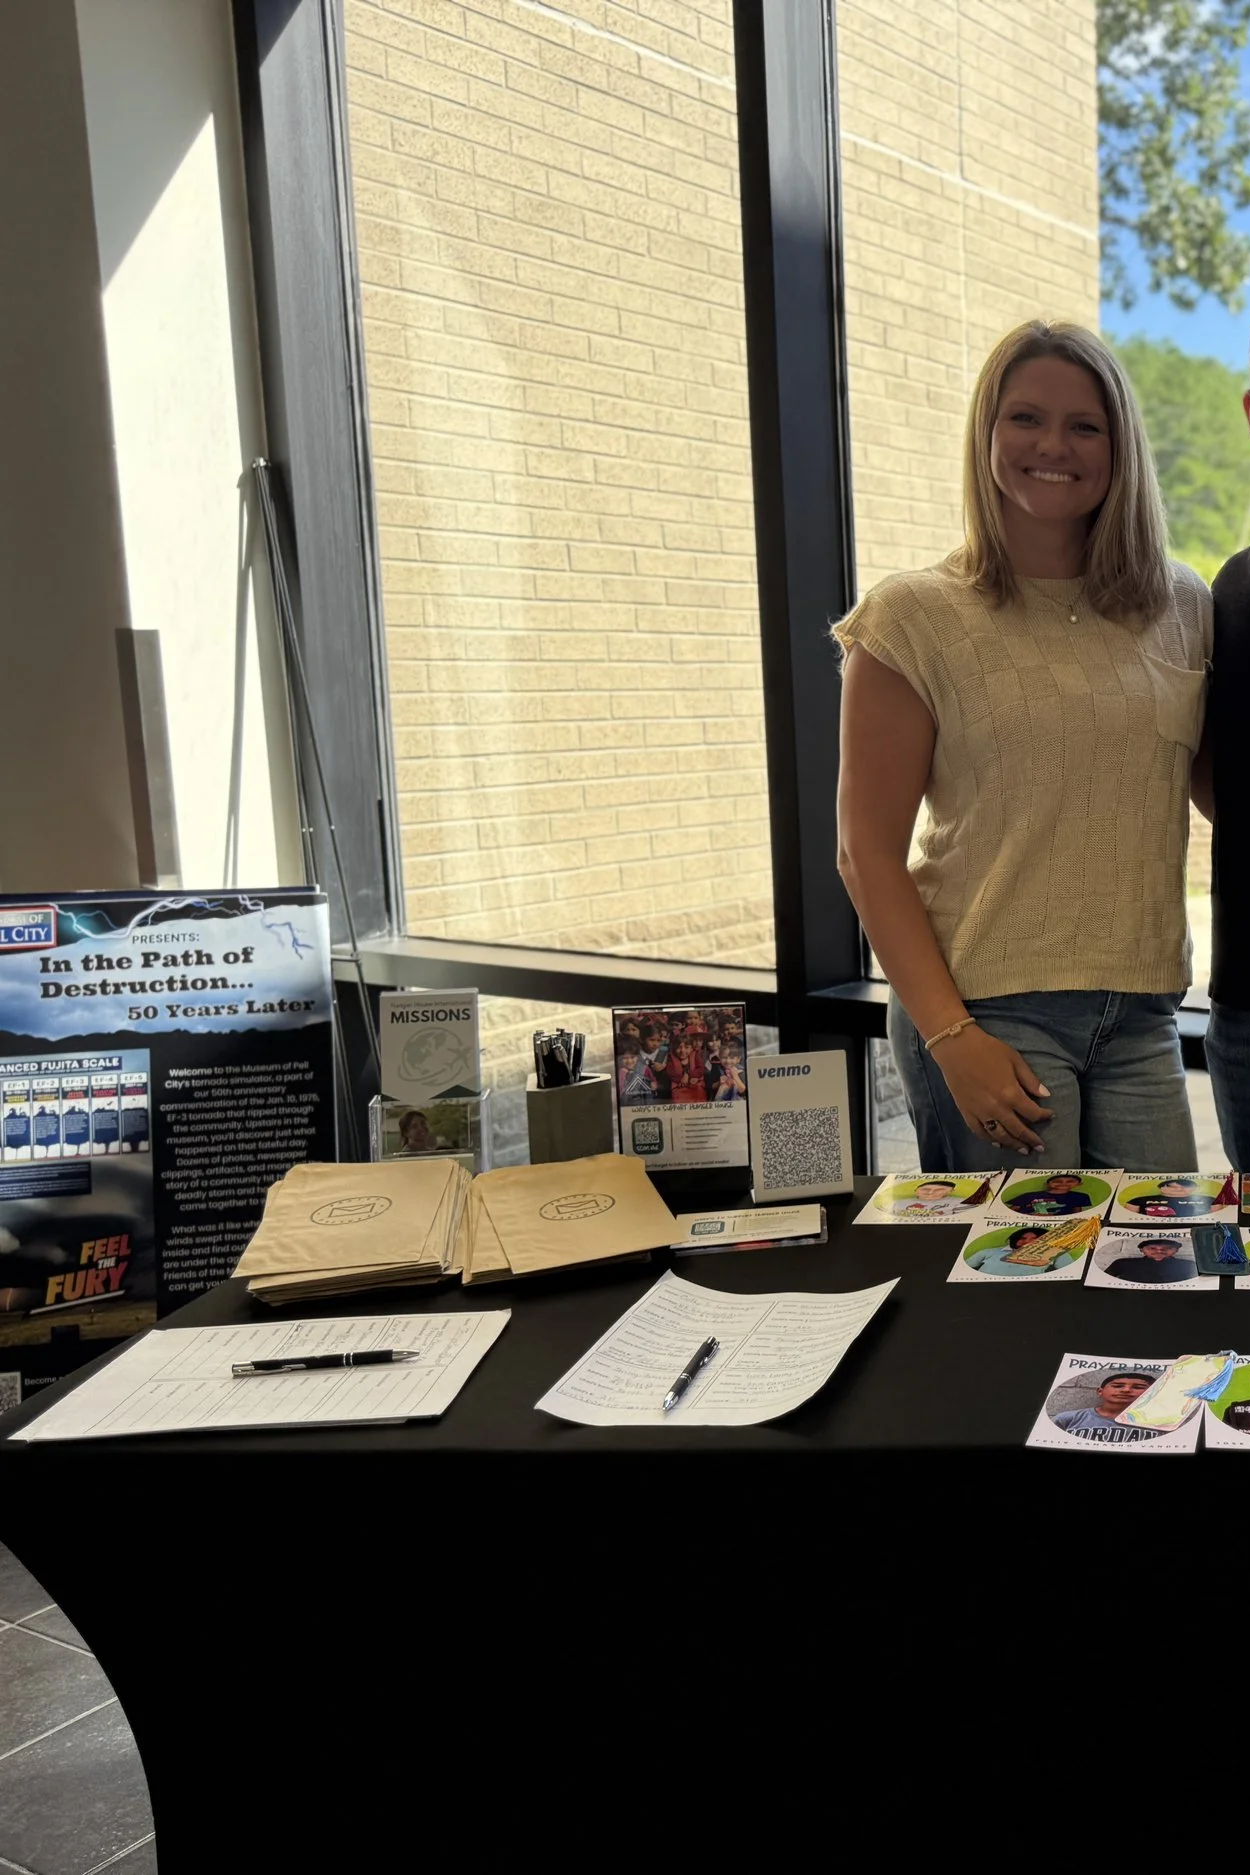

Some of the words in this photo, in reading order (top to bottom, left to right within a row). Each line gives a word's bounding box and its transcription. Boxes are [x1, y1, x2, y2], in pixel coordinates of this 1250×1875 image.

[29, 914, 44, 924] OF
[12, 926, 49, 942] CITY
[132, 932, 200, 945] PRESENTS:
[39, 954, 73, 974] In
[82, 952, 134, 971] the
[141, 949, 214, 969] Path
[223, 947, 255, 965] of
[40, 974, 254, 999] Destruction...
[128, 1004, 159, 1021] 50
[166, 1002, 239, 1019] Years
[246, 999, 316, 1015] Later
[390, 1008, 471, 1024] MISSIONS
[0, 1062, 39, 1073] ANCED
[41, 1059, 80, 1070] FUJITA
[82, 1056, 120, 1068] SCALE
[169, 1067, 213, 1078] Welcome
[214, 1066, 224, 1075] to
[226, 1065, 240, 1074] the
[242, 1063, 281, 1073] Museum
[282, 1062, 292, 1070] of
[293, 1061, 309, 1070] Pell
[757, 1064, 811, 1079] venmo
[165, 1080, 190, 1090] City's
[192, 1077, 228, 1087] tornado
[230, 1074, 274, 1085] simulator,
[284, 1073, 303, 1083] part
[304, 1071, 314, 1080] of
[194, 1090, 209, 1098] our
[212, 1088, 232, 1097] 50th
[234, 1085, 286, 1096] anniversary
[160, 1100, 237, 1112] commemoration
[239, 1098, 248, 1106] of
[249, 1096, 265, 1105] the
[167, 1113, 187, 1122] EF-3
[189, 1111, 225, 1121] tornado
[227, 1108, 246, 1118] that
[247, 1107, 277, 1118] ripped
[278, 1105, 314, 1116] through
[173, 1124, 188, 1133] the
[190, 1121, 244, 1132] community.
[246, 1118, 282, 1128] Upstairs
[283, 1117, 292, 1125] in
[294, 1116, 309, 1125] the
[167, 1134, 209, 1145] museum,
[211, 1132, 234, 1143] you'll
[236, 1130, 273, 1140] discover
[275, 1128, 292, 1138] just
[293, 1127, 316, 1136] what
[175, 1144, 222, 1156] happened
[224, 1143, 236, 1151] on
[238, 1141, 257, 1150] that
[258, 1139, 287, 1149] fateful
[176, 1157, 209, 1167] Dozens
[211, 1155, 220, 1164] of
[222, 1153, 256, 1165] photos,
[257, 1150, 307, 1162] newspaper
[161, 1168, 205, 1180] clippings,
[206, 1165, 246, 1176] artifacts,
[247, 1164, 266, 1172] and
[267, 1162, 291, 1170] more
[165, 1181, 189, 1191] story
[190, 1179, 200, 1188] of
[210, 1175, 261, 1187] community
[263, 1173, 276, 1182] hit
[175, 1190, 207, 1200] deadly
[208, 1187, 236, 1198] storm
[237, 1186, 256, 1195] and
[180, 1201, 207, 1211] come
[208, 1199, 247, 1211] together
[249, 1198, 259, 1206] to
[171, 1225, 196, 1234] What
[198, 1223, 217, 1233] was
[218, 1222, 225, 1230] it
[226, 1221, 242, 1230] like
[1107, 1230, 1154, 1238] PRAYER
[1158, 1231, 1192, 1239] PART
[166, 1236, 194, 1246] winds
[195, 1234, 223, 1244] swept
[80, 1233, 131, 1265] FEEL
[162, 1248, 190, 1258] inside
[192, 1246, 210, 1255] and
[212, 1244, 230, 1253] find
[97, 1256, 117, 1269] THE
[163, 1260, 179, 1269] are
[181, 1258, 208, 1268] under
[210, 1256, 226, 1265] the
[163, 1270, 197, 1281] Friends
[200, 1268, 208, 1277] of
[209, 1267, 225, 1276] the
[45, 1260, 128, 1306] FURY
[168, 1282, 187, 1292] can
[188, 1280, 205, 1291] get
[1069, 1358, 1128, 1371] PRAYER
[1133, 1363, 1172, 1372] PART
[24, 1376, 57, 1386] Become
